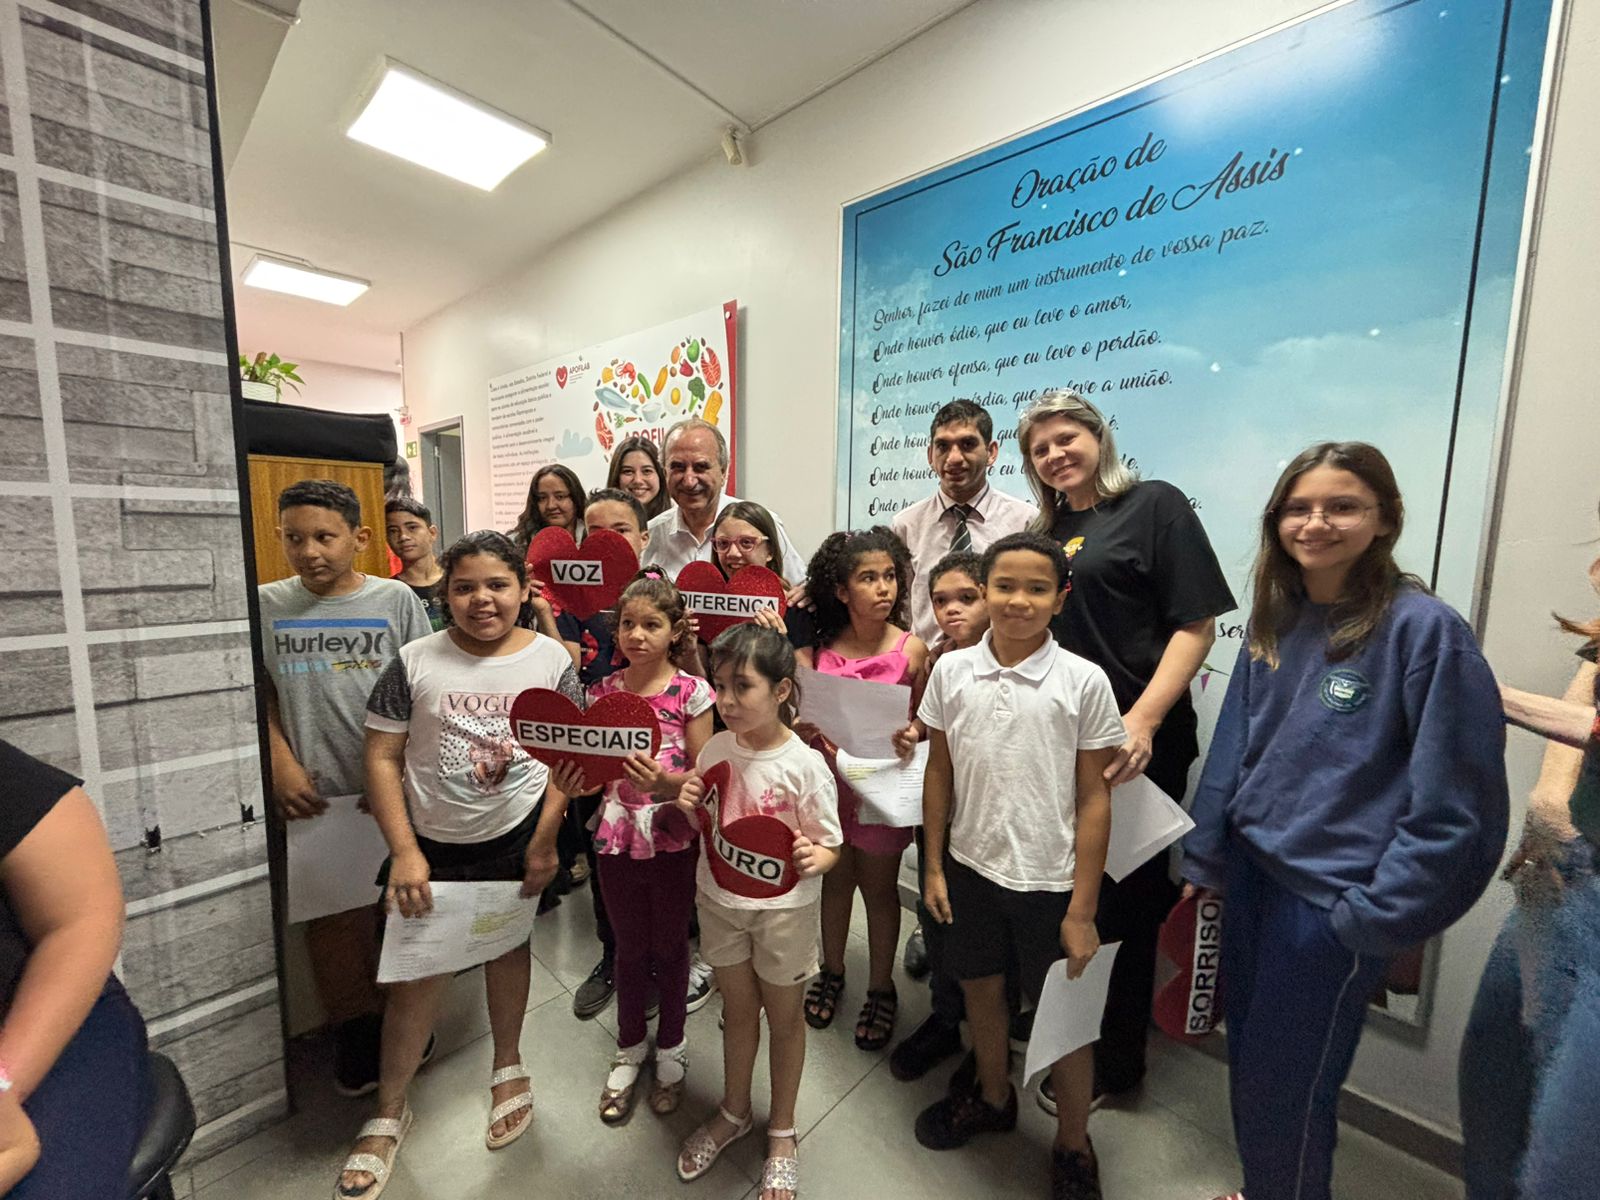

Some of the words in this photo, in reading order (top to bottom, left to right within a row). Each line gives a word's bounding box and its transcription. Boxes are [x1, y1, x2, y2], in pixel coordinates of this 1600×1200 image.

[1011, 155, 1118, 208] Oração
[1124, 131, 1167, 170] de
[934, 240, 982, 277] São
[986, 206, 1118, 262] Francisco
[1125, 185, 1168, 221] de
[1171, 148, 1290, 211] Assis
[873, 308, 915, 331] Senhor,
[917, 296, 950, 325] fazei
[953, 291, 971, 306] de
[974, 285, 1002, 301] mim
[1007, 278, 1029, 294] um
[1035, 253, 1125, 288] instrumento
[1131, 245, 1155, 264] de
[1162, 235, 1214, 257] vossa
[1218, 221, 1269, 254] paz.
[873, 340, 904, 362] Onde
[907, 333, 945, 351] houver
[950, 325, 980, 342] ódio,
[985, 320, 1008, 342] que
[1013, 316, 1029, 330] eu
[1034, 308, 1064, 326] leve
[1069, 304, 1080, 318] o
[1084, 295, 1131, 316] amor,
[872, 373, 903, 394] Onde
[906, 366, 944, 384] houver
[948, 359, 990, 386] ofensa,
[994, 355, 1019, 376] que
[1023, 352, 1040, 365] eu
[1045, 345, 1076, 361] leve
[1081, 342, 1092, 355] o
[1096, 329, 1162, 361] perdão.
[871, 405, 902, 425] Onde
[1011, 389, 1038, 410] que
[1101, 380, 1114, 392] a
[1119, 370, 1173, 388] união.
[870, 436, 900, 456] Onde
[903, 435, 931, 449] houv
[869, 467, 900, 487] Onde
[1000, 465, 1016, 476] eu
[868, 497, 898, 516] Onde
[552, 563, 601, 583] VOZ
[275, 632, 359, 655] Hurley
[519, 722, 650, 750] ESPECIAIS
[1189, 902, 1220, 1031] SORRISO
